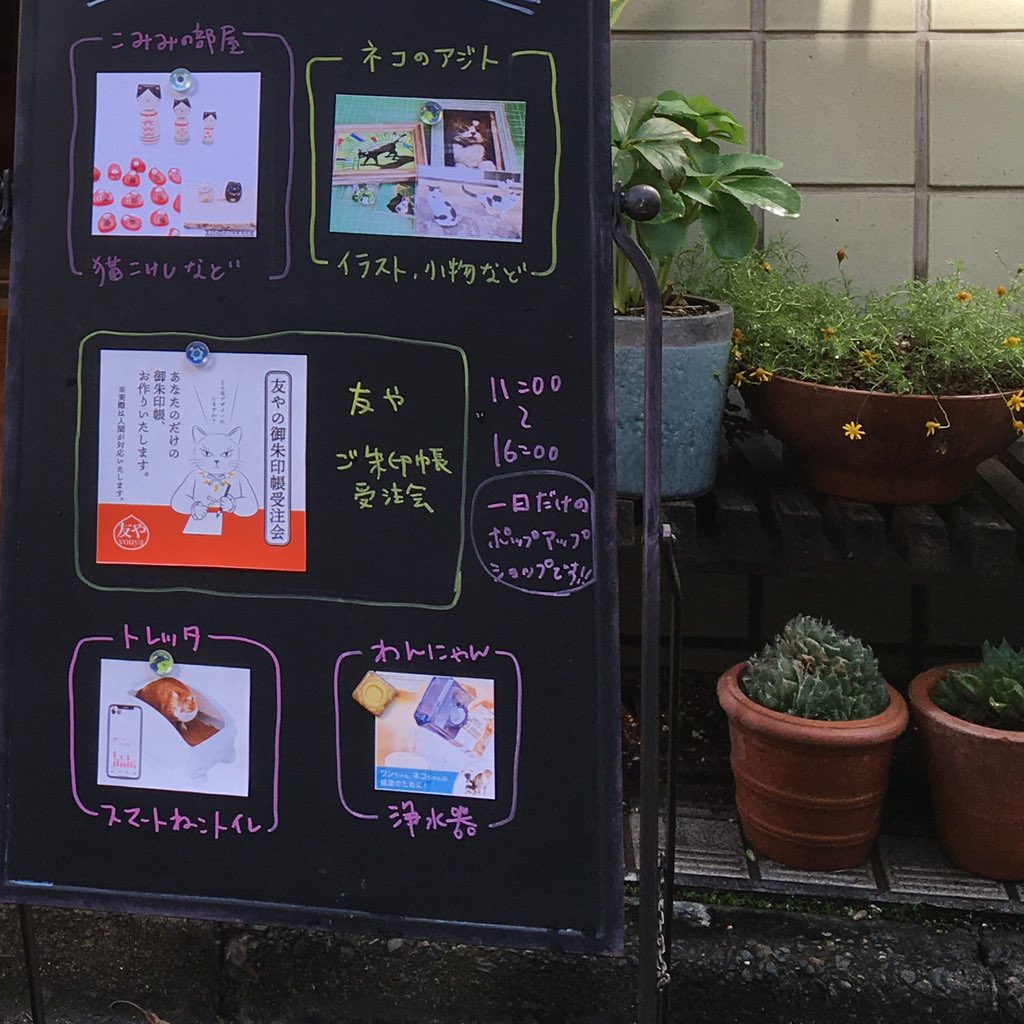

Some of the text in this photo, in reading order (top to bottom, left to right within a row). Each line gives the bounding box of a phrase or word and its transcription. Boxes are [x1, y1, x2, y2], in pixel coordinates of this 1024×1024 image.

[110, 23, 247, 56] こみみの部屋
[361, 42, 499, 71] ネコのアジト
[349, 381, 406, 416] 友や
[137, 371, 151, 477] お作りいたします。
[168, 370, 181, 460] あなたのだけの
[269, 378, 287, 541] 友やの御朱印帳受注会
[335, 445, 453, 479] ご朱印帳
[354, 482, 435, 514] 受注会
[487, 489, 590, 513] 一日だけの
[117, 521, 147, 538] 友や
[488, 526, 592, 551] ポップアップ
[122, 623, 203, 650] トレッタ
[371, 639, 491, 664] わんにゃん
[388, 799, 479, 841] 浄水器
